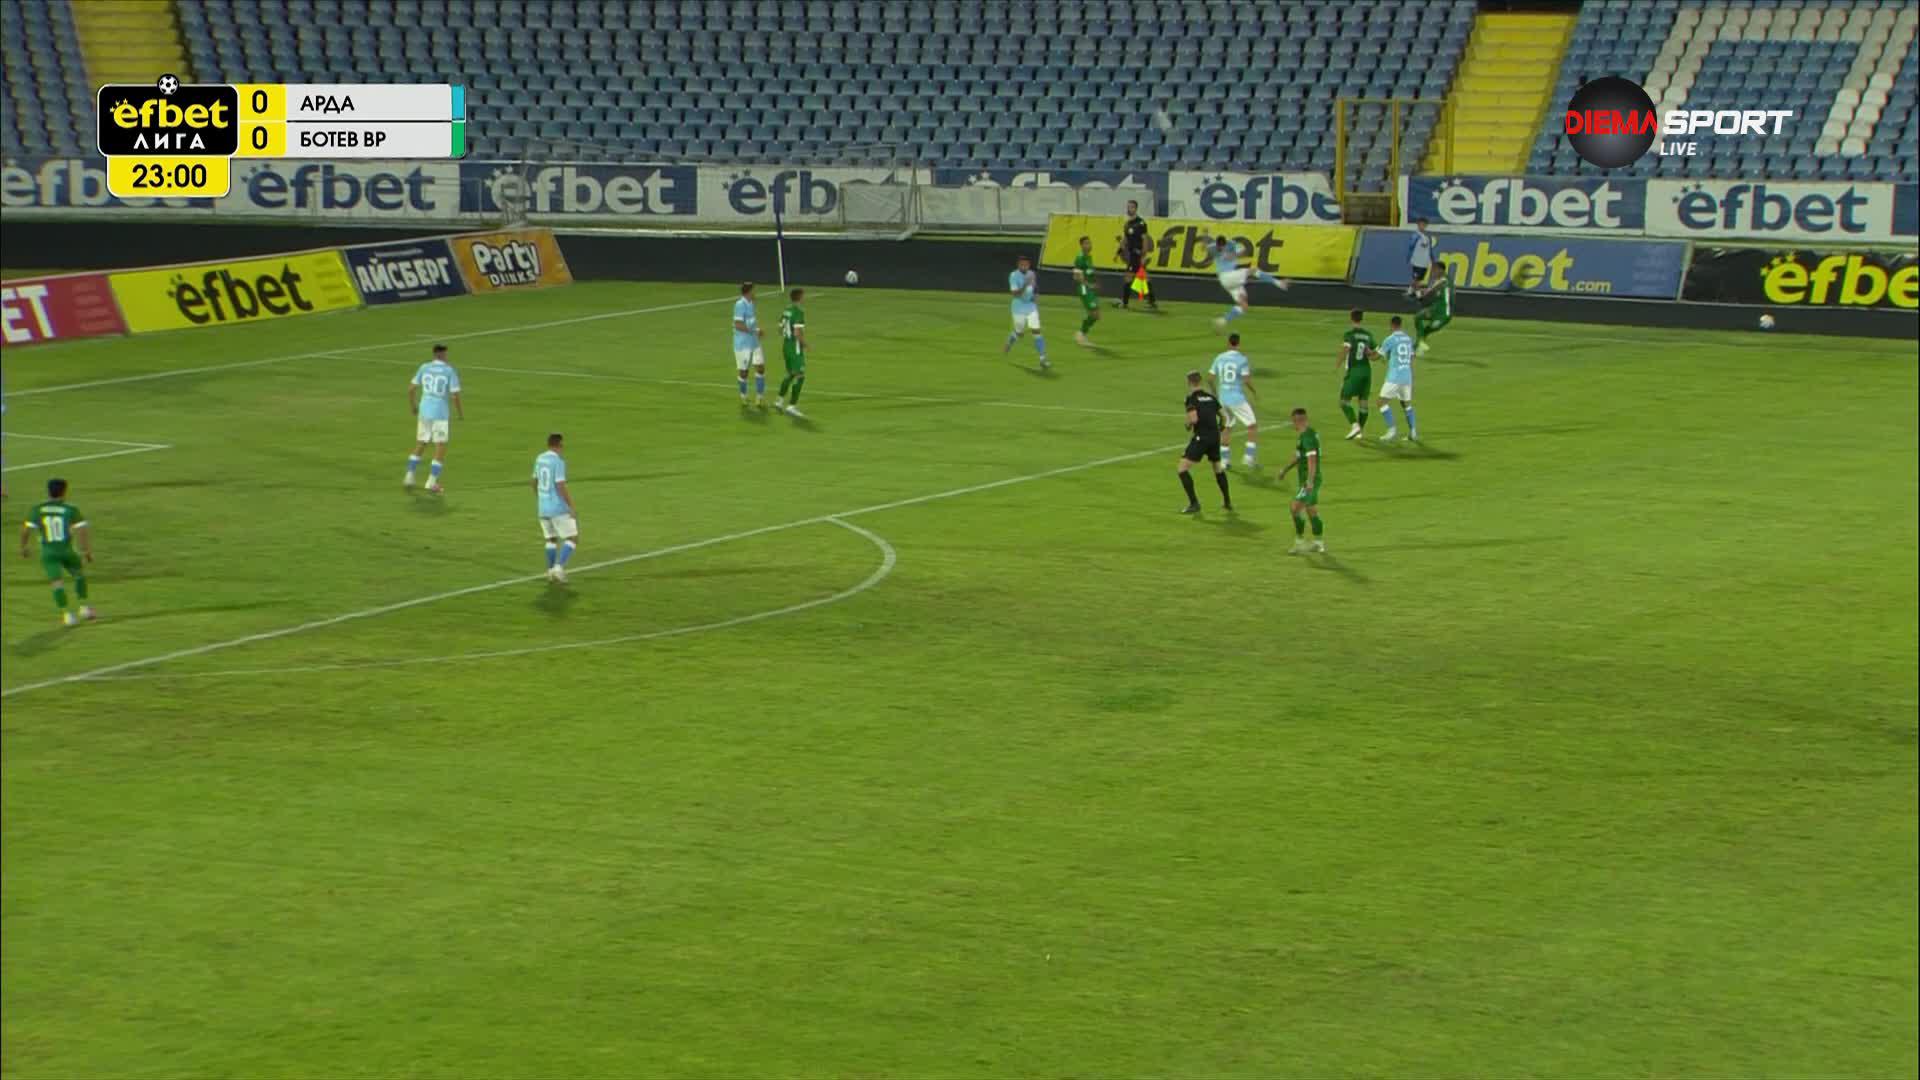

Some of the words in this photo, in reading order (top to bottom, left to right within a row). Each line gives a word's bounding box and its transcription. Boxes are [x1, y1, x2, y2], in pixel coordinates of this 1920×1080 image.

[725, 169, 908, 215] efb
[471, 241, 541, 274] Party
[355, 256, 451, 293] АЙСБЕРГ
[1217, 361, 1238, 383] 16
[41, 515, 66, 543] 10
